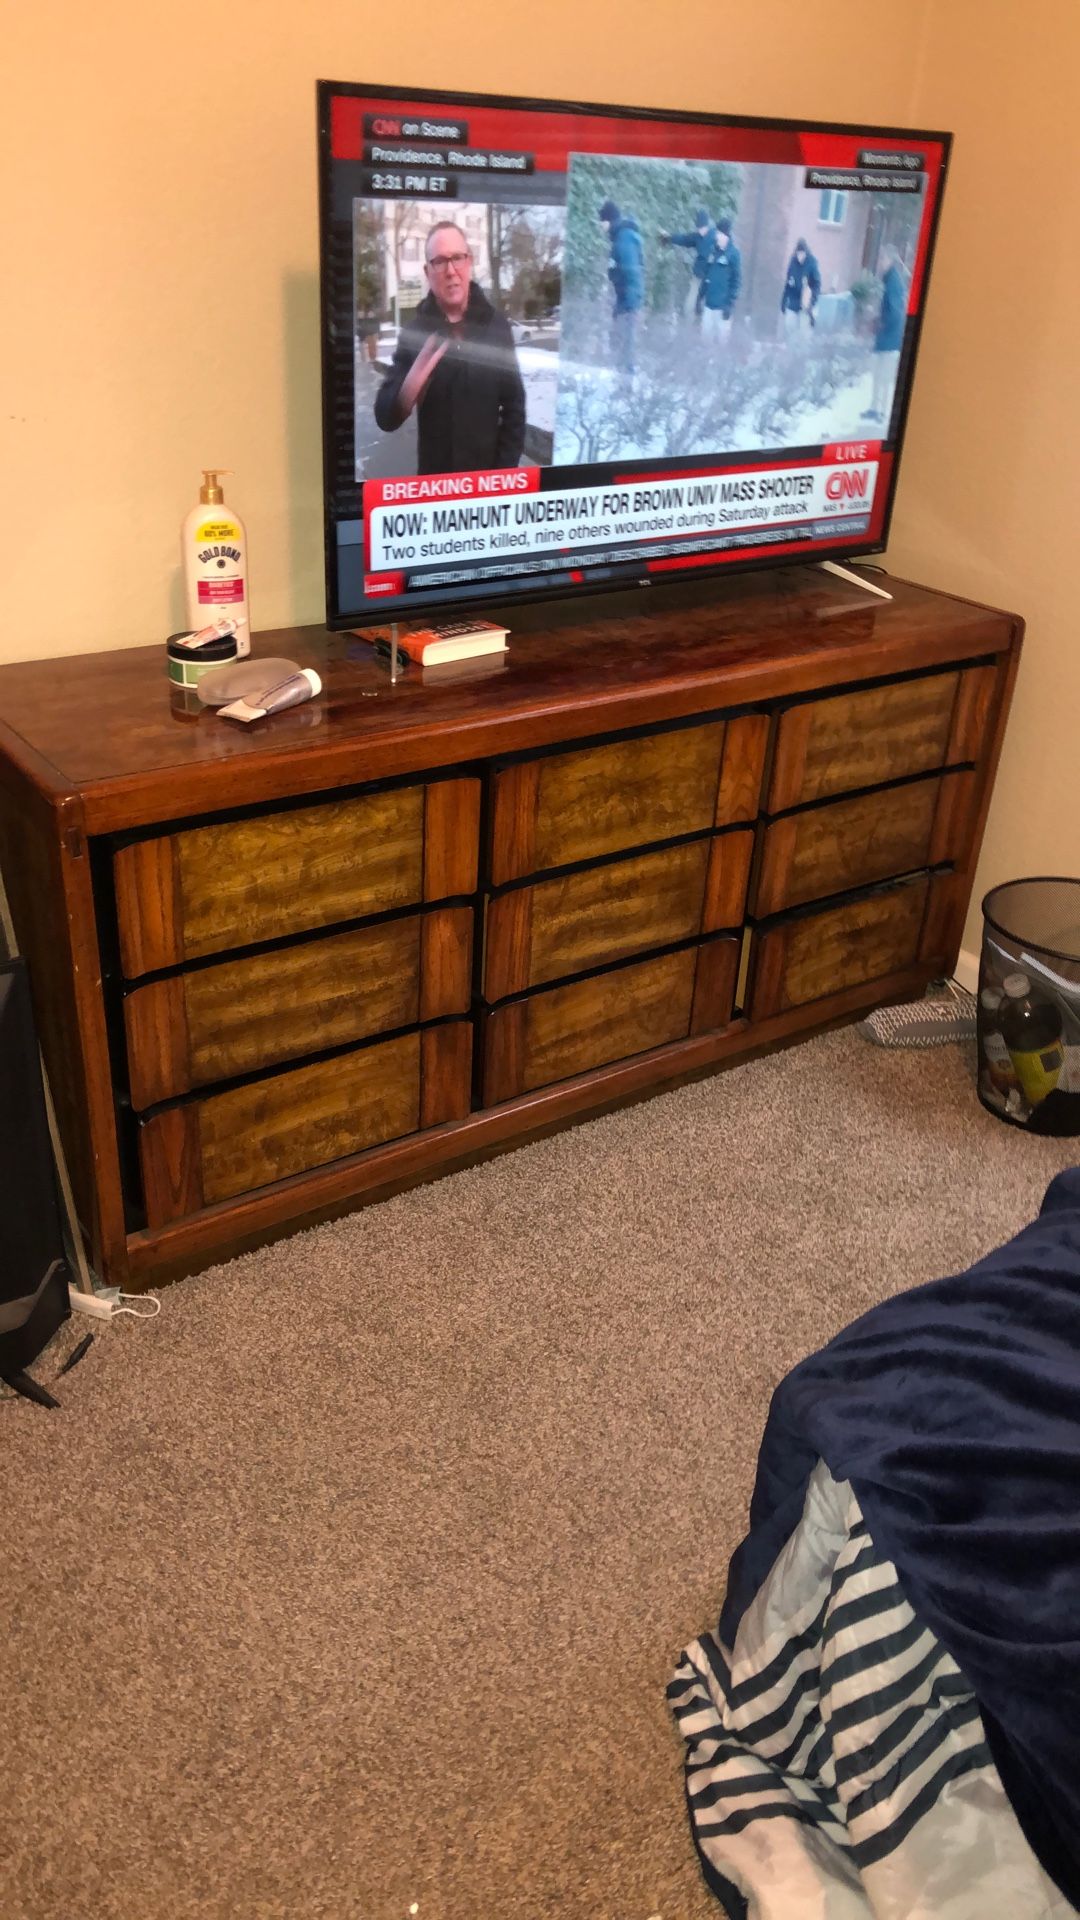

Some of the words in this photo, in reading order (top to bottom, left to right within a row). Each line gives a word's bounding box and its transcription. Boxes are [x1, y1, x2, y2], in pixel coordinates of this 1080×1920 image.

[402, 123, 419, 136] on
[421, 122, 460, 139] Scene
[371, 147, 446, 166] Providence,
[448, 151, 488, 168] Rhode
[489, 154, 527, 170] Island
[372, 174, 402, 190] 3:31
[404, 176, 427, 191] PM
[428, 177, 448, 192] ET
[836, 444, 867, 461] LIVE
[382, 477, 473, 501] BREAKING
[478, 472, 528, 493] NEWS
[825, 468, 869, 501] CNN
[382, 512, 428, 539] NOW:
[432, 504, 511, 534] MANHUNT
[515, 496, 599, 525] UNDERWAY
[602, 492, 630, 516] FOR
[633, 487, 684, 513] BROWN
[687, 484, 718, 507] UNIV
[721, 480, 756, 504] MASS
[758, 475, 814, 500] SHOOTER
[382, 545, 416, 561] Two
[420, 537, 485, 557] students
[490, 531, 530, 549] killed,
[535, 529, 564, 544] nine
[568, 524, 611, 540] others
[614, 515, 674, 535] wounded
[677, 511, 715, 528] during
[718, 505, 770, 523] Saturday
[773, 500, 808, 517] attack
[198, 546, 220, 563] GOLD
[220, 545, 241, 563] BOND
